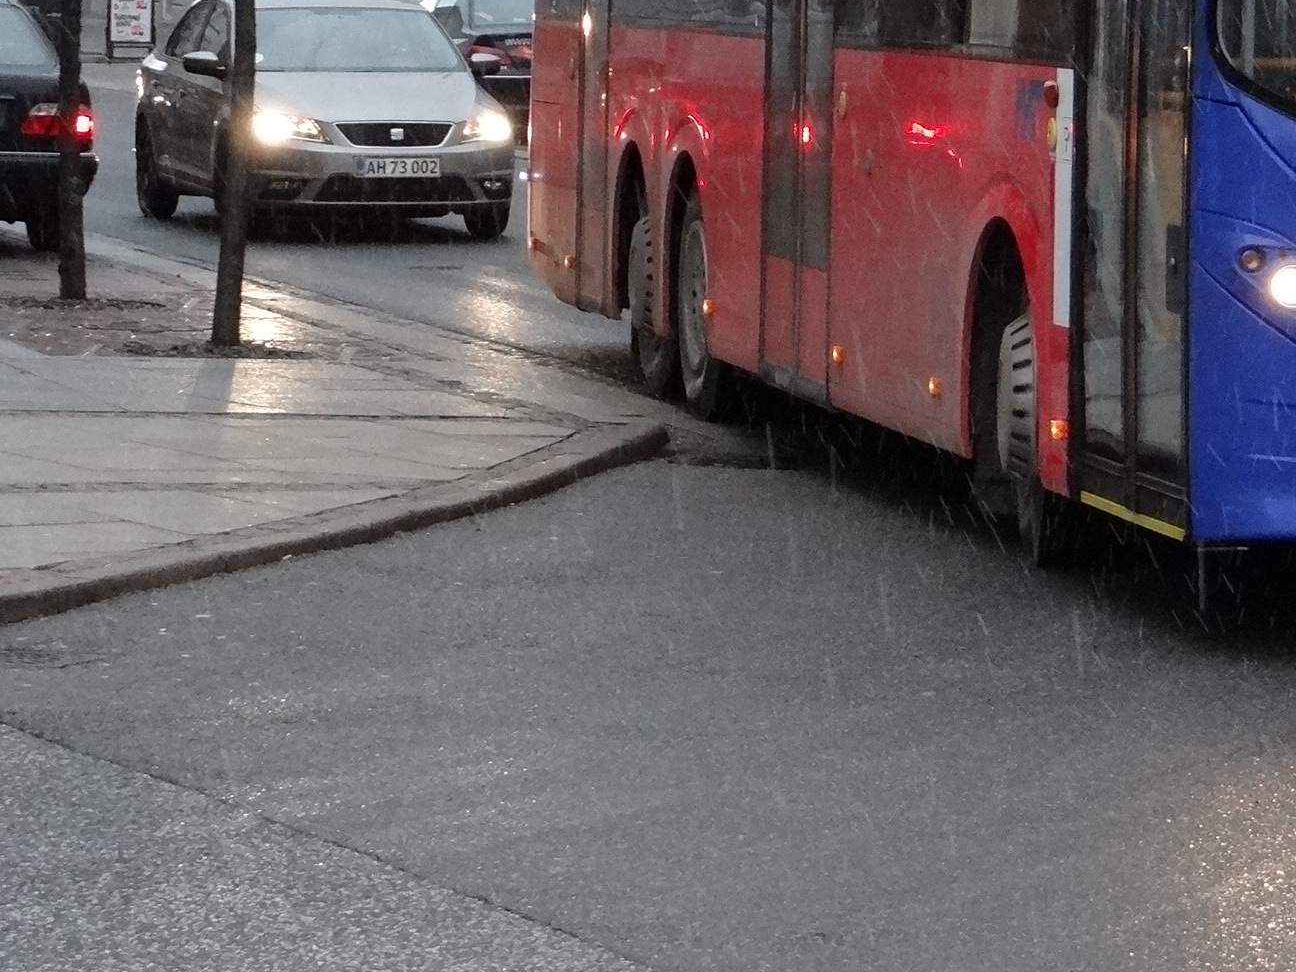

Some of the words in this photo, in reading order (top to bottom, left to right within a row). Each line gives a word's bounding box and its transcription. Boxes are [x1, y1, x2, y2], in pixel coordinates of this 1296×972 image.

[366, 160, 387, 175] AH
[390, 160, 408, 175] 73
[411, 160, 438, 175] 002
